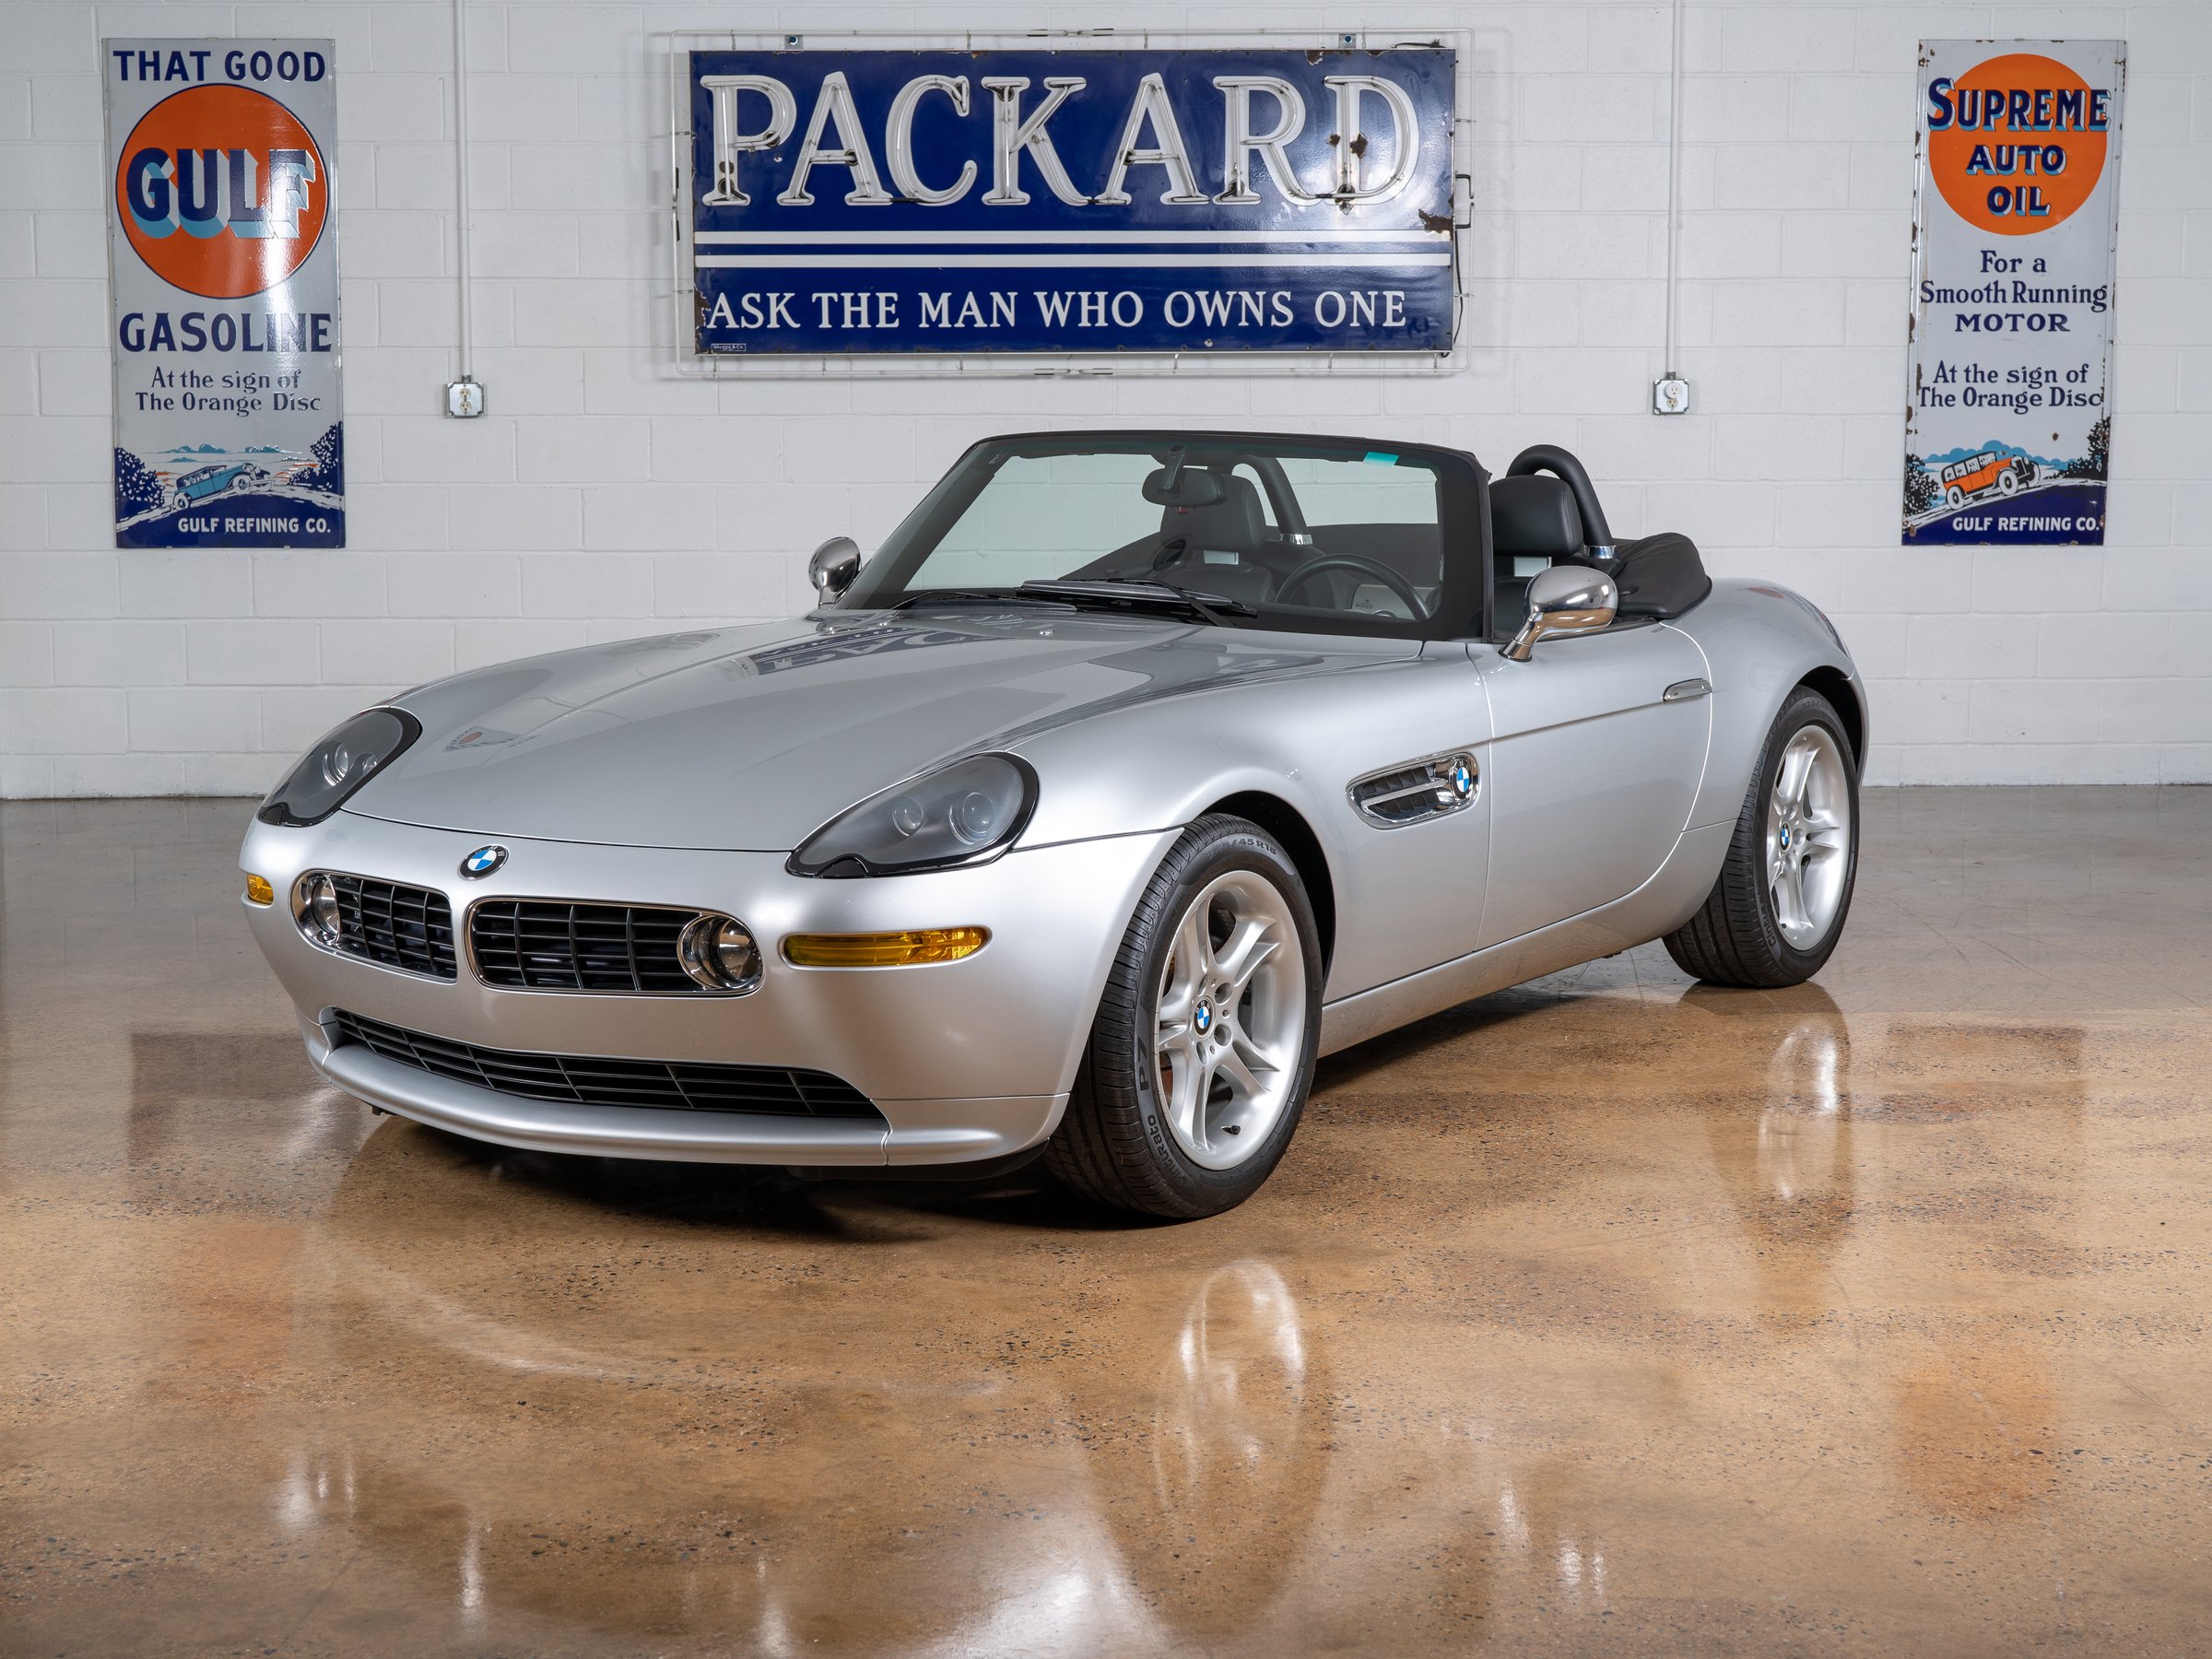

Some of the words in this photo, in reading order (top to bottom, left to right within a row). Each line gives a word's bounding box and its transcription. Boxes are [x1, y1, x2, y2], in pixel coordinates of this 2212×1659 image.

[113, 50, 211, 81] THAT
[225, 50, 325, 82] GOOD
[1927, 77, 2112, 132] SUPREME
[700, 71, 1419, 206] PACKARD
[1965, 144, 2066, 176] AUTO
[126, 147, 315, 239] GULF
[1987, 185, 2051, 217] OIL
[1980, 250, 2022, 273] For
[2032, 256, 2047, 273] a
[707, 292, 800, 329] ASK
[812, 292, 900, 328] THE
[918, 292, 1018, 328] MAN
[1032, 290, 1144, 327] WHO
[1164, 290, 1294, 327] OWNS
[1314, 290, 1406, 327] ONE
[1920, 280, 2007, 304] Smooth
[2012, 280, 2108, 312] Running
[119, 312, 332, 353] GASOLINE
[1955, 313, 2071, 332] MOTOR
[151, 366, 175, 388] At
[180, 370, 214, 389] the
[221, 371, 271, 394] sign
[277, 369, 301, 389] of
[1933, 360, 1957, 383] At
[1964, 363, 1998, 383] the
[2006, 366, 2057, 389] sign
[2066, 363, 2089, 383] of
[135, 392, 174, 411] The
[182, 392, 263, 418] Orange
[273, 392, 322, 411] Disc
[1920, 386, 1956, 407] The
[1963, 386, 2042, 415] Orange
[2049, 386, 2101, 406] Disc
[178, 518, 219, 533] GULF
[225, 518, 300, 533] REFINING
[305, 518, 331, 533] CO.
[1952, 517, 1993, 531] GULF
[1998, 517, 2072, 531] REFINING
[2076, 517, 2100, 532] CO.
[1207, 838, 1254, 861] 5/45
[1137, 1036, 1149, 1091] P7
